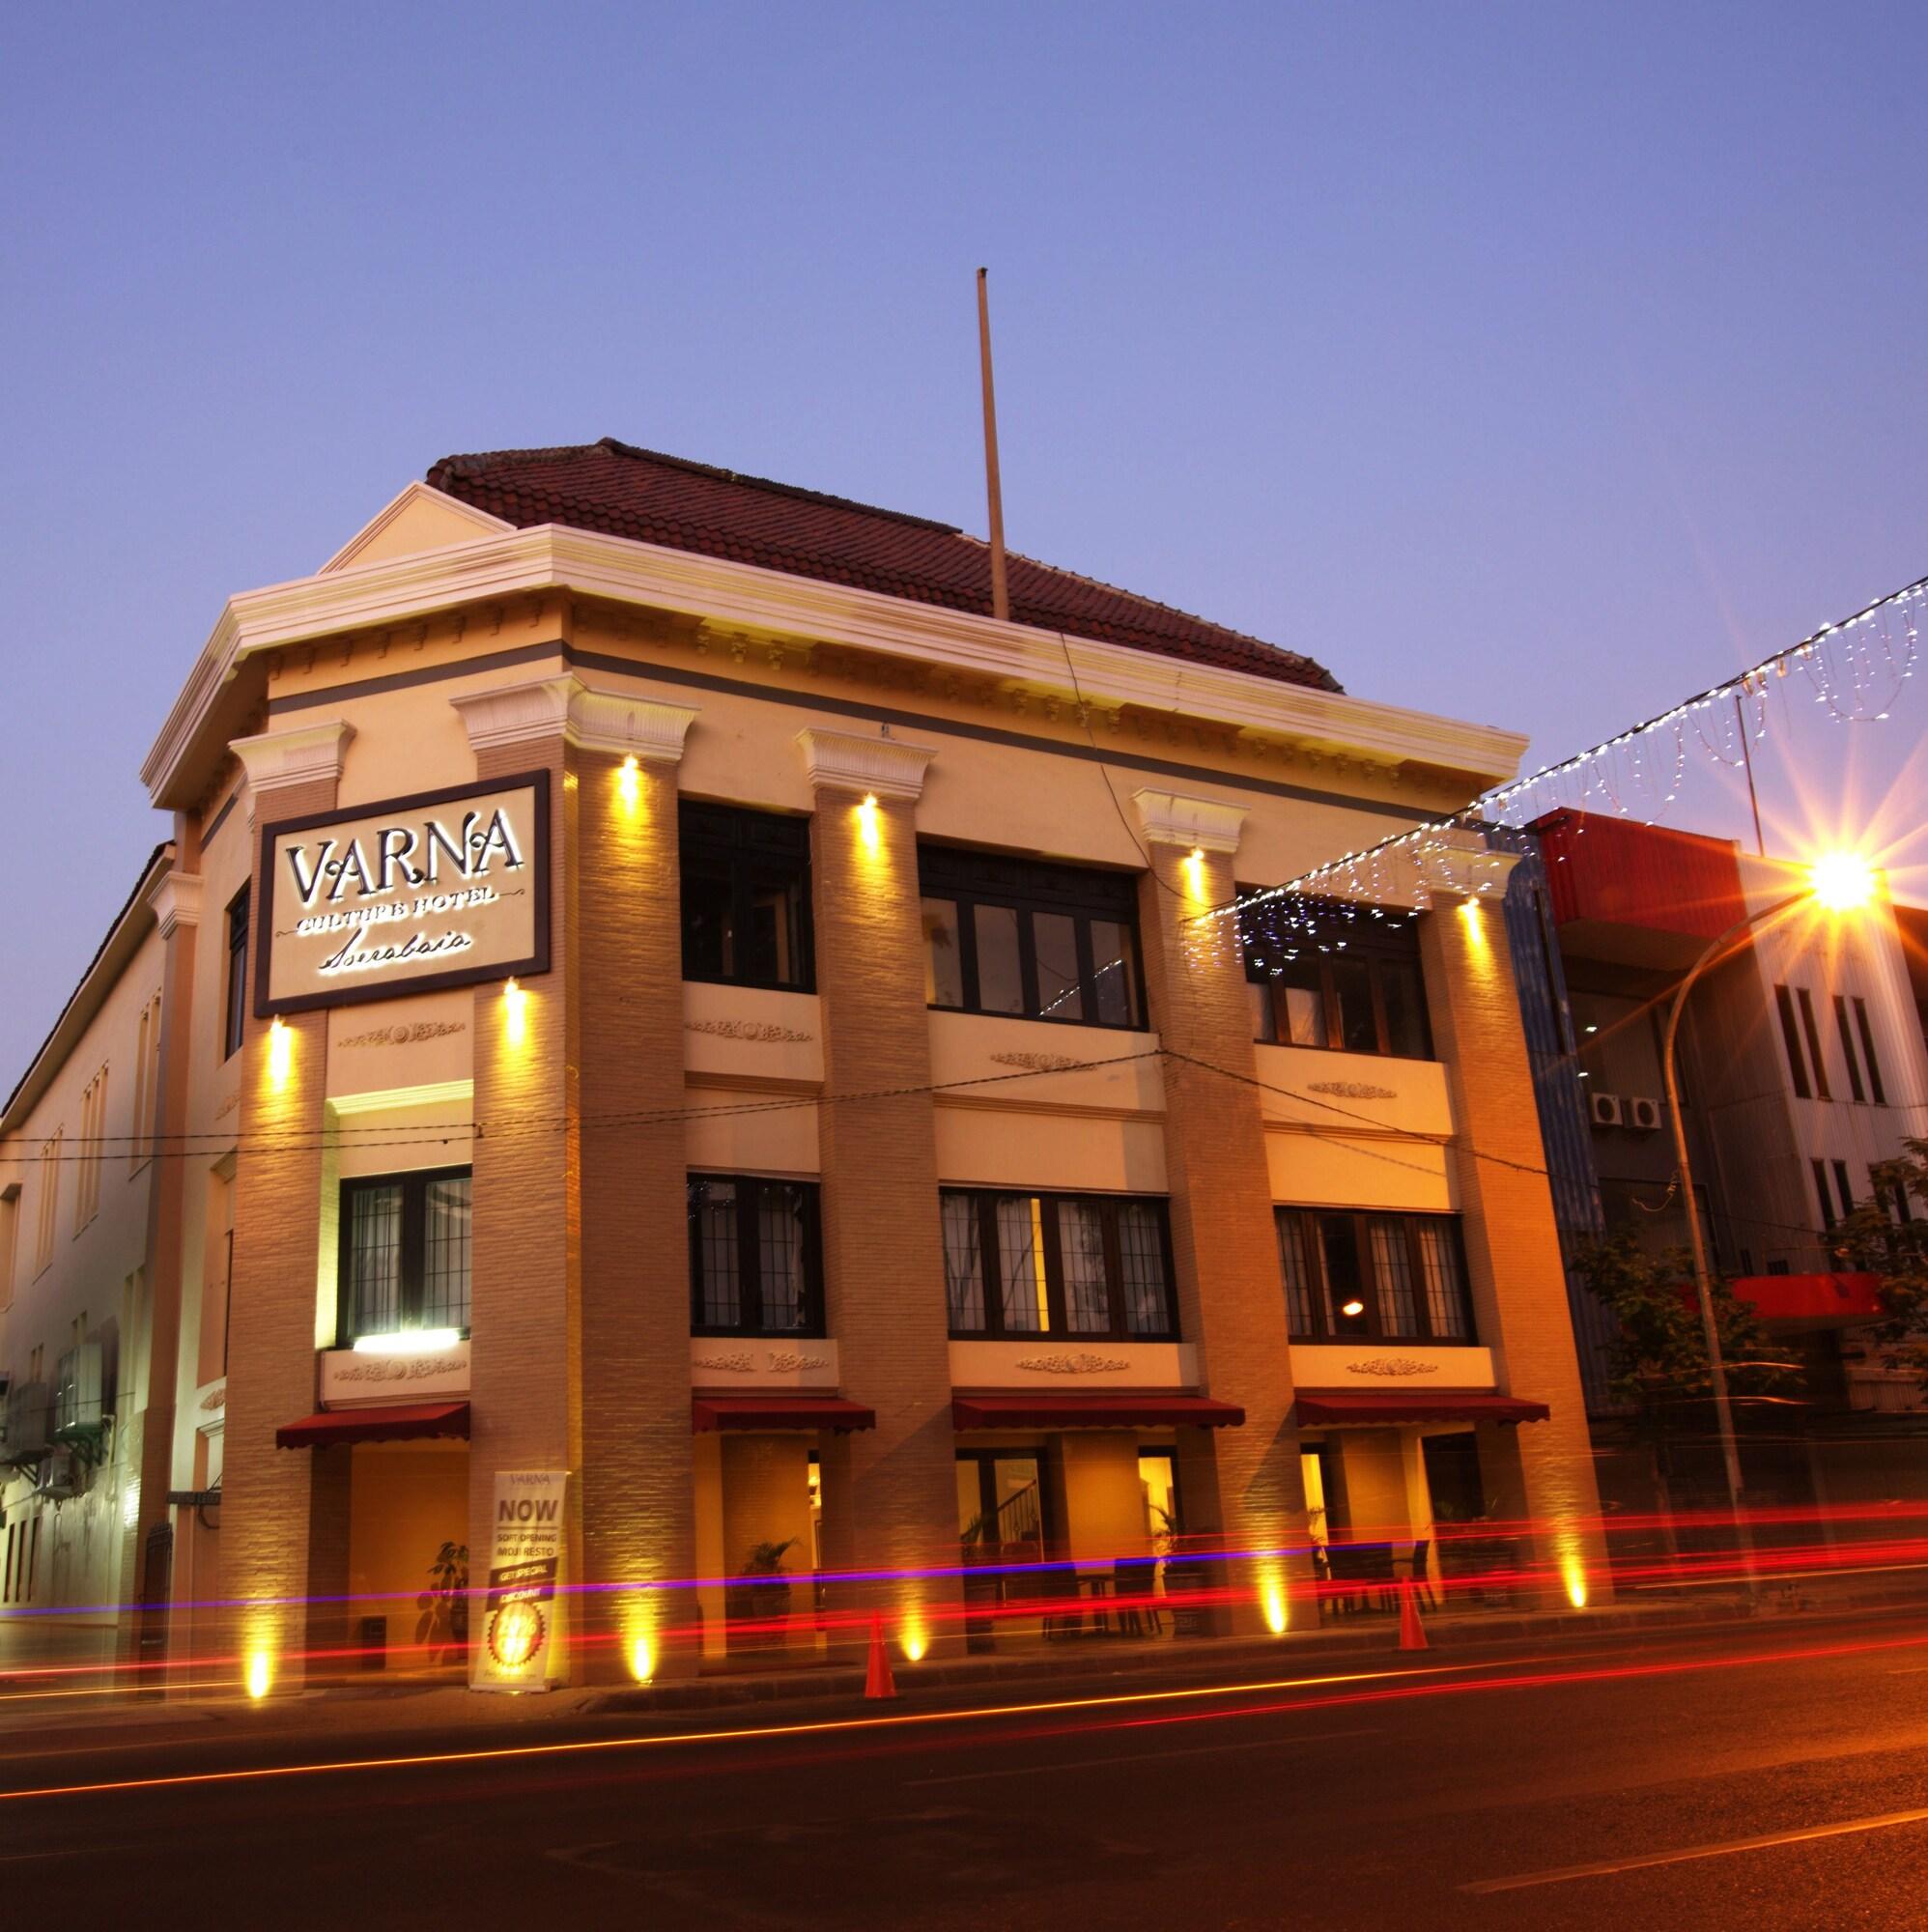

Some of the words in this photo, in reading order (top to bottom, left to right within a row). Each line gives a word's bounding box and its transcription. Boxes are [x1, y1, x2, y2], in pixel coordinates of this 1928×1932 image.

[286, 809, 525, 904] VARNA
[297, 901, 406, 933] CULTURE
[412, 887, 497, 914] HOTEL
[319, 927, 472, 970] Soerabaia
[510, 1474, 551, 1485] VARNA
[498, 1499, 558, 1522] NOW
[497, 1533, 518, 1543] SOFT
[520, 1533, 557, 1543] OPENING
[524, 1547, 554, 1557] RESTO
[515, 1564, 548, 1578] SPECIAL
